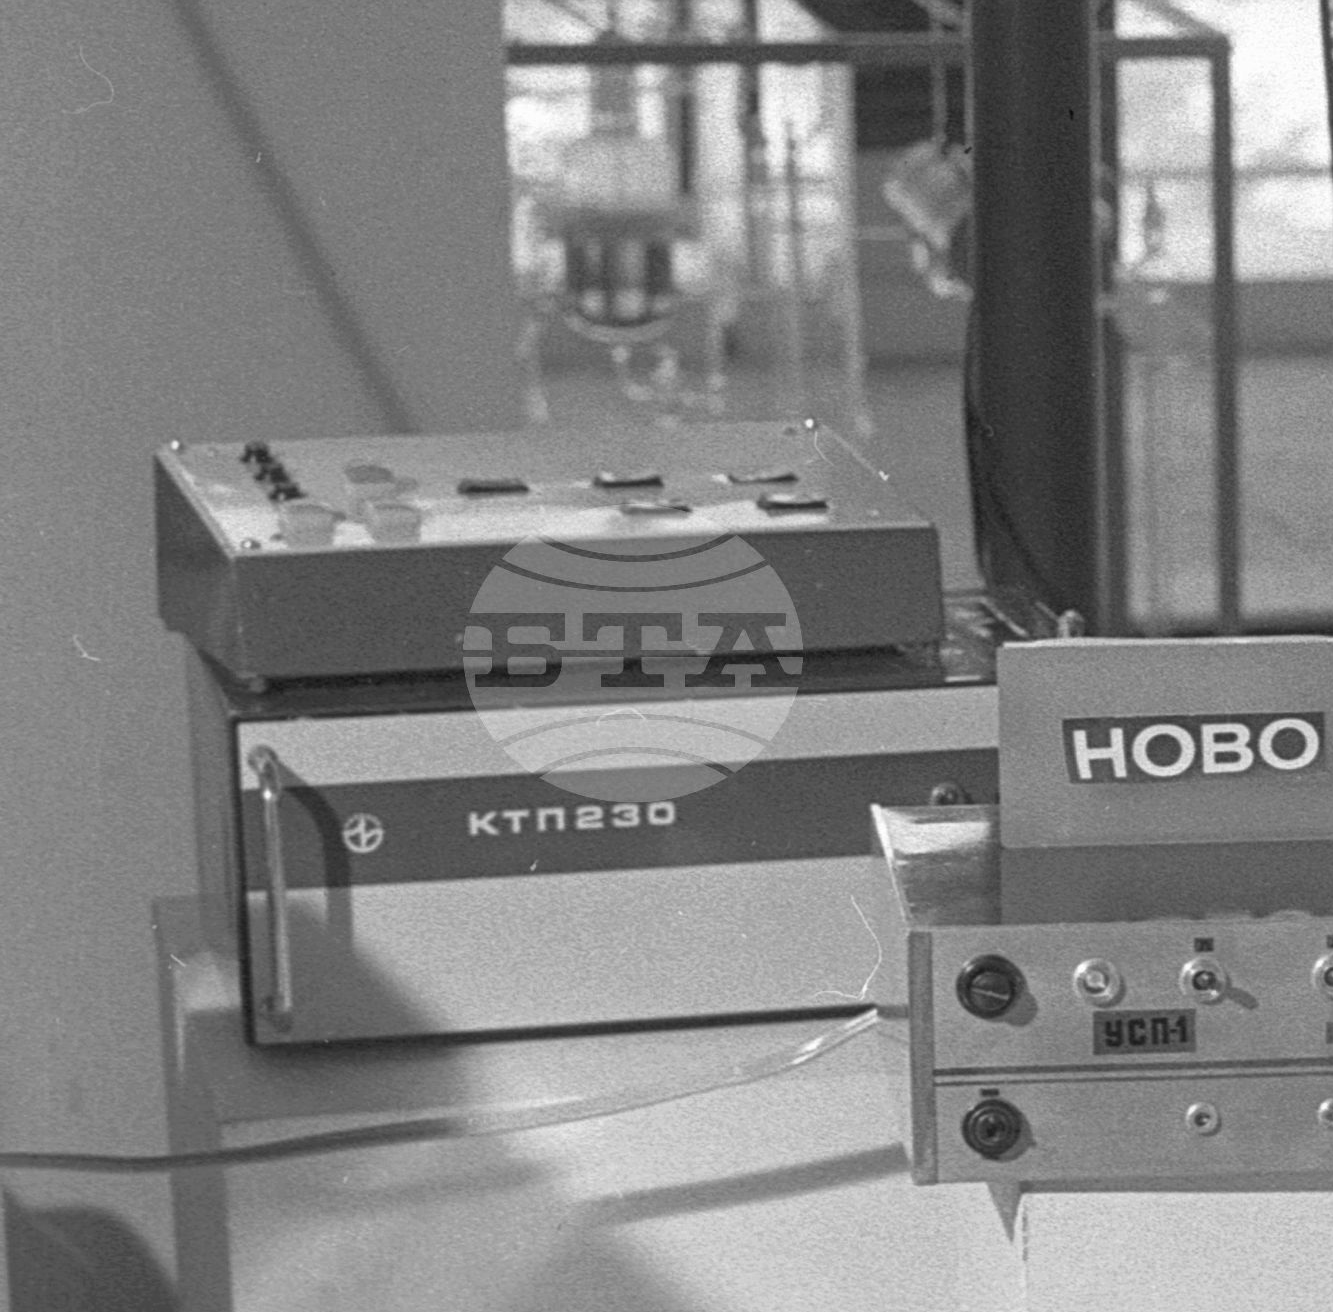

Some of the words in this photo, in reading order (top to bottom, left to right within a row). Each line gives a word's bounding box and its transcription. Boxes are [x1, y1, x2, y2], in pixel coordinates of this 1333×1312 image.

[1073, 718, 1320, 780] НОВО
[468, 801, 677, 836] КТП230
[1105, 1015, 1187, 1047] УСП-1
